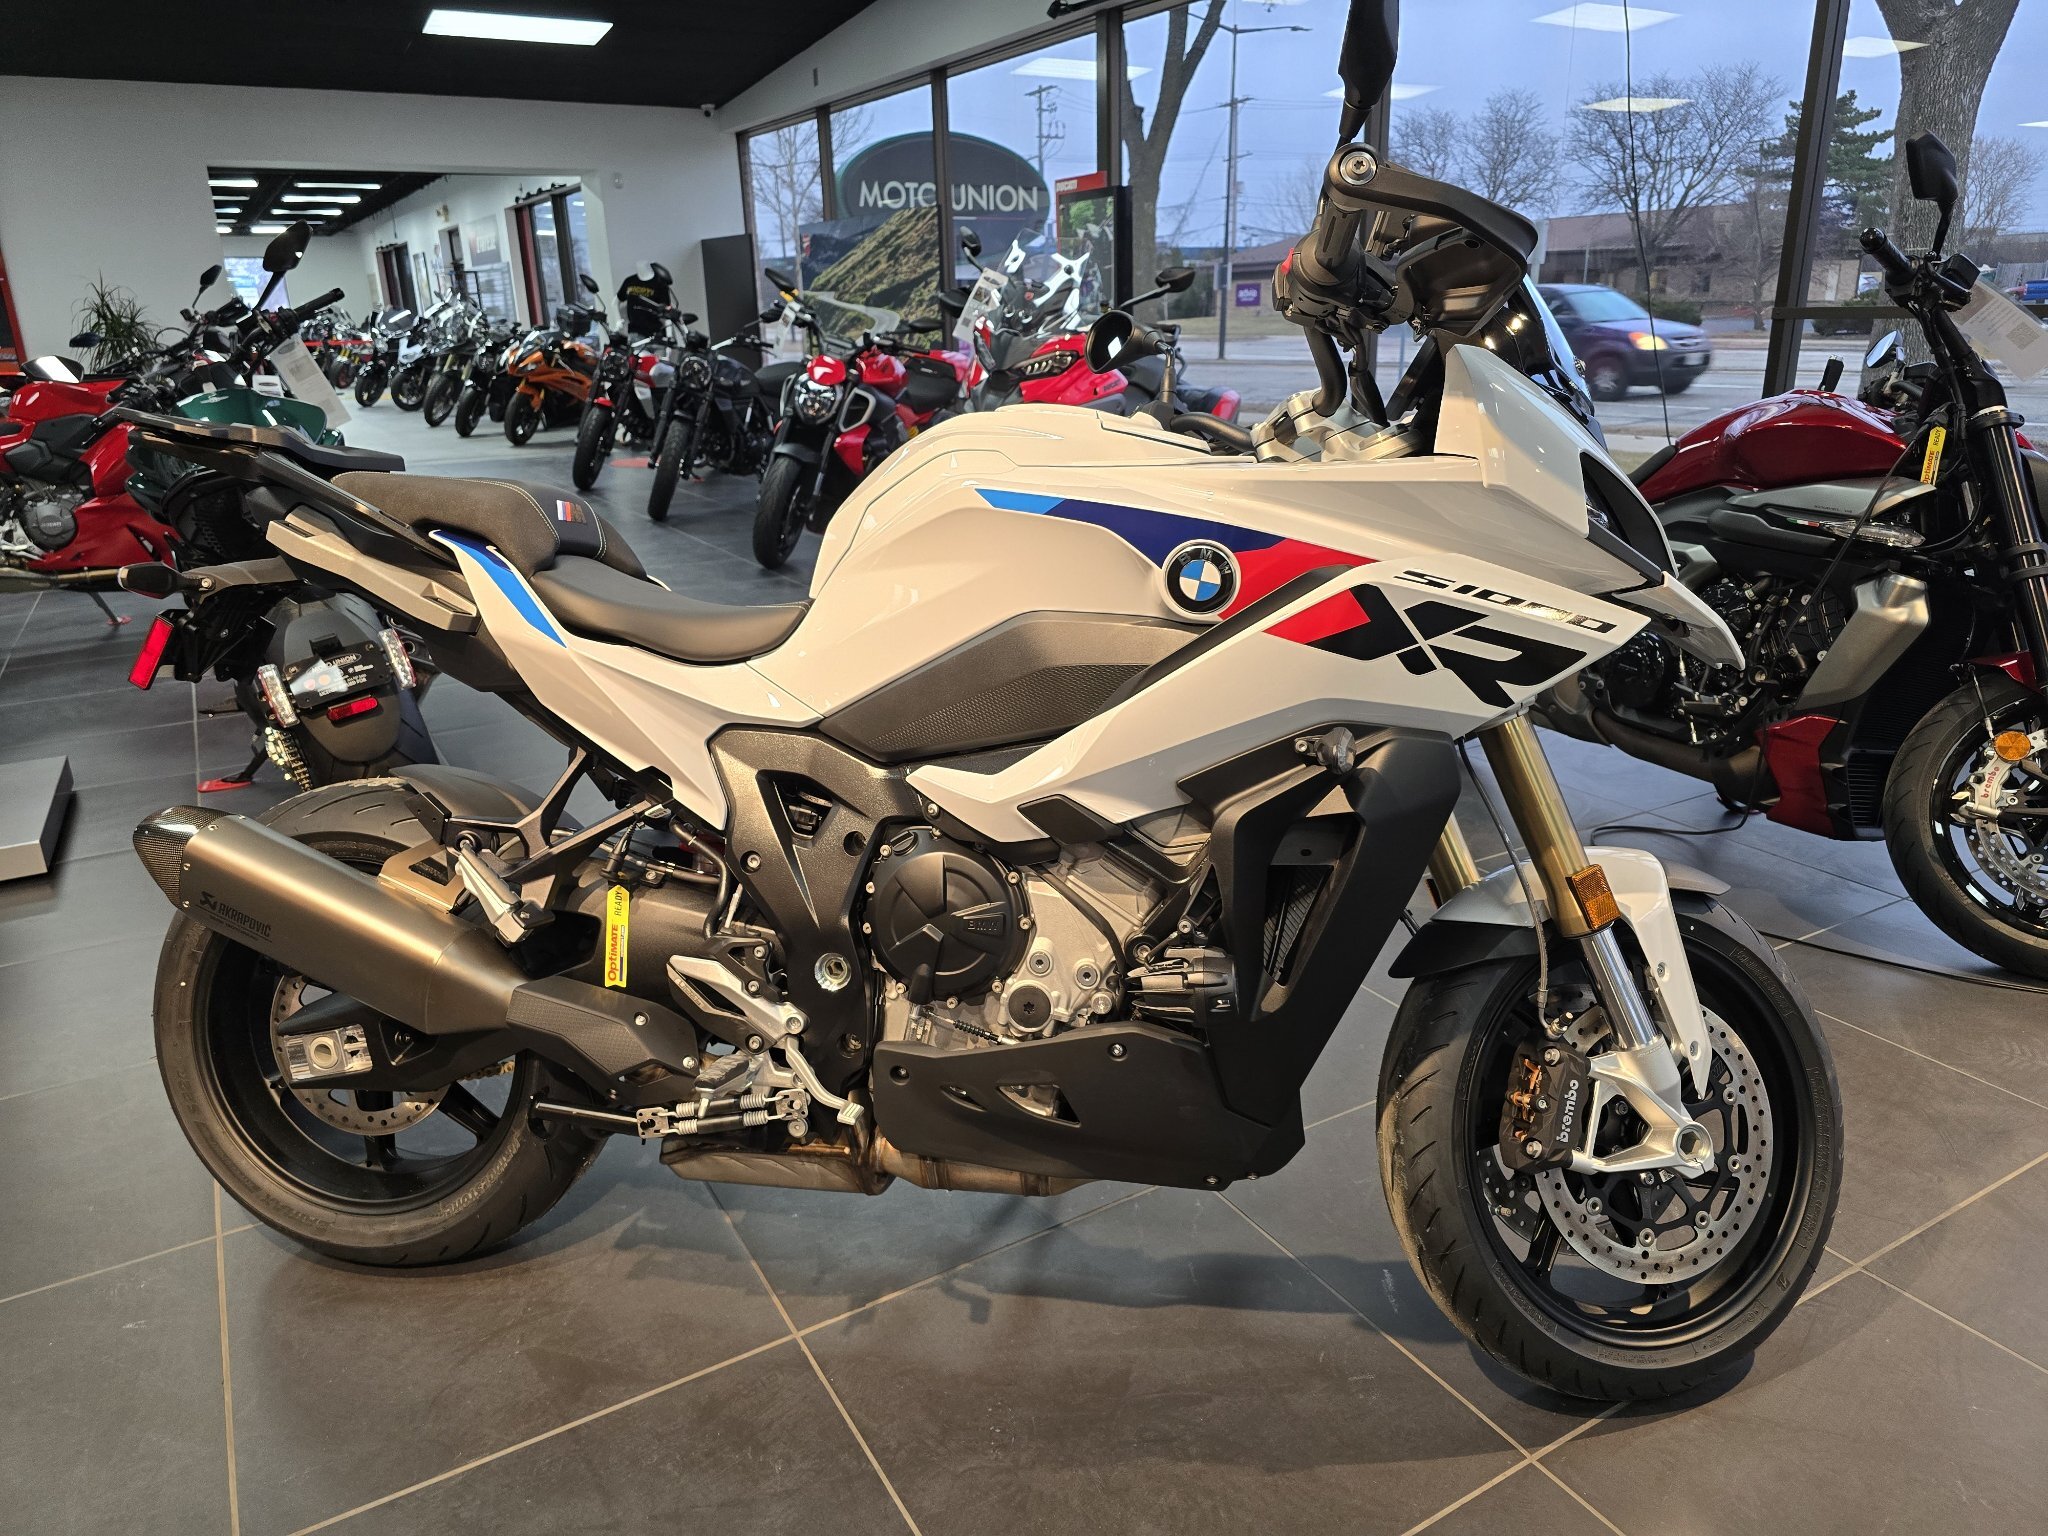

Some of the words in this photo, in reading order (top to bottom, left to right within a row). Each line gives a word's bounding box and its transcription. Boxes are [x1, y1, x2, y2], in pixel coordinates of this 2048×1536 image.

[951, 184, 1038, 212] UNION
[1932, 428, 1941, 447] READY
[1178, 547, 1232, 575] BMW
[1393, 569, 1617, 634] S1000
[1305, 583, 1588, 709] XR
[1980, 766, 2001, 799] brembo
[608, 923, 619, 982] OptiMATE
[614, 890, 623, 917] READY
[1556, 1079, 1579, 1143] brembo
